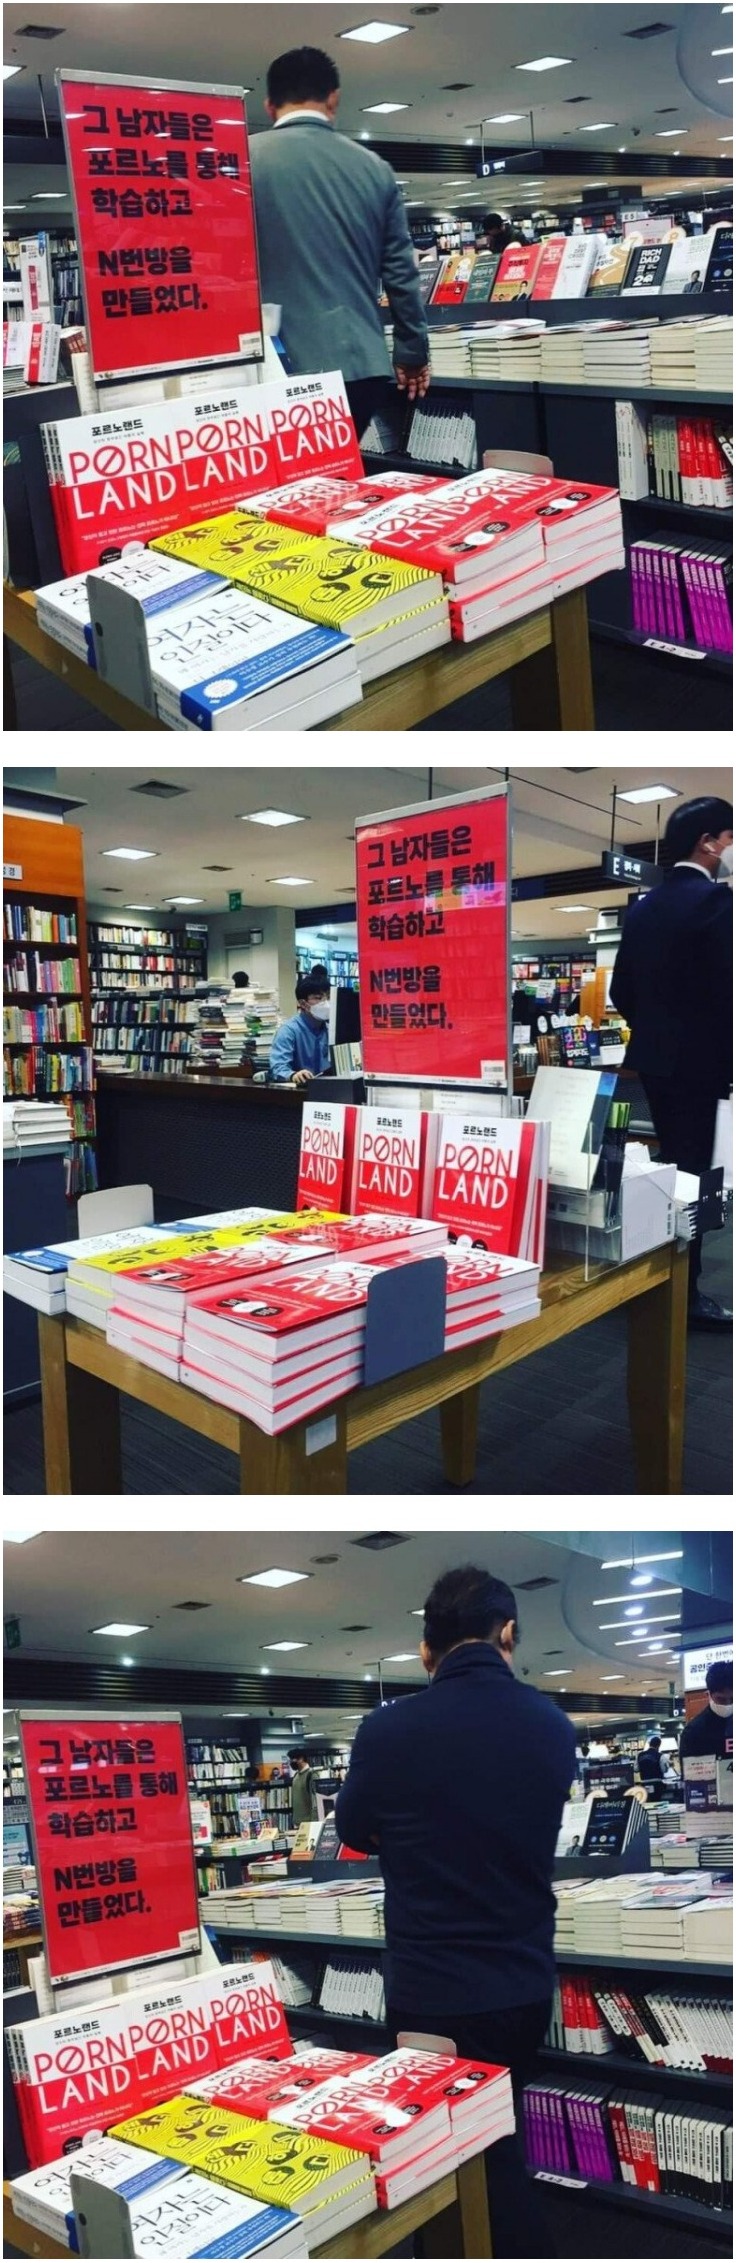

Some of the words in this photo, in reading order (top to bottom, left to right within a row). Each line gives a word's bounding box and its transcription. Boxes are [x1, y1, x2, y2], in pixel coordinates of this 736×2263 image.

[83, 105, 109, 133] 그
[116, 107, 214, 142] 남자들은
[88, 148, 188, 179] 포르노를
[196, 150, 240, 180] 통해
[482, 163, 490, 176] D
[91, 187, 193, 218] 학습하고
[97, 246, 192, 276] N번방을
[639, 255, 661, 265] DAD
[641, 248, 663, 257] RICH
[102, 283, 208, 319] 만들었다.
[286, 382, 323, 398] 포르노랜드
[194, 399, 238, 416] 포르노랜드
[91, 419, 144, 437] 포르노랜드
[276, 421, 352, 462] LAND
[182, 447, 268, 491] LAND
[72, 471, 177, 520] LAND
[379, 503, 471, 549] LAND
[160, 612, 273, 664] 인질이다
[367, 843, 385, 869] 그
[391, 825, 472, 868] 남자들은
[367, 869, 444, 905] 포르노를
[451, 861, 495, 895] 통해
[613, 857, 620, 876] E
[368, 907, 445, 941] 학습하고
[370, 965, 441, 994] N번방을
[371, 1003, 453, 1030] 만들었다.
[299, 1152, 338, 1186] LAND
[359, 1161, 413, 1198] LAND
[438, 1169, 509, 1210] LAND
[39, 1739, 64, 1765] 그
[69, 1739, 156, 1766] 남자들은
[44, 1773, 133, 1802] 포르노를
[139, 1772, 178, 1797] 통해
[48, 1808, 138, 1838] 학습하고
[53, 1857, 137, 1892] N번방을
[57, 1889, 152, 1929] 만들었다.
[222, 1972, 255, 1988] 포르노랜드
[143, 1995, 182, 2012] 포르노랜드
[54, 2020, 100, 2038] 포르노랜드
[215, 2006, 281, 2047] LAND
[135, 2035, 209, 2080] LAND
[38, 2064, 131, 2114] LAND
[140, 2195, 231, 2246] 인질이다
